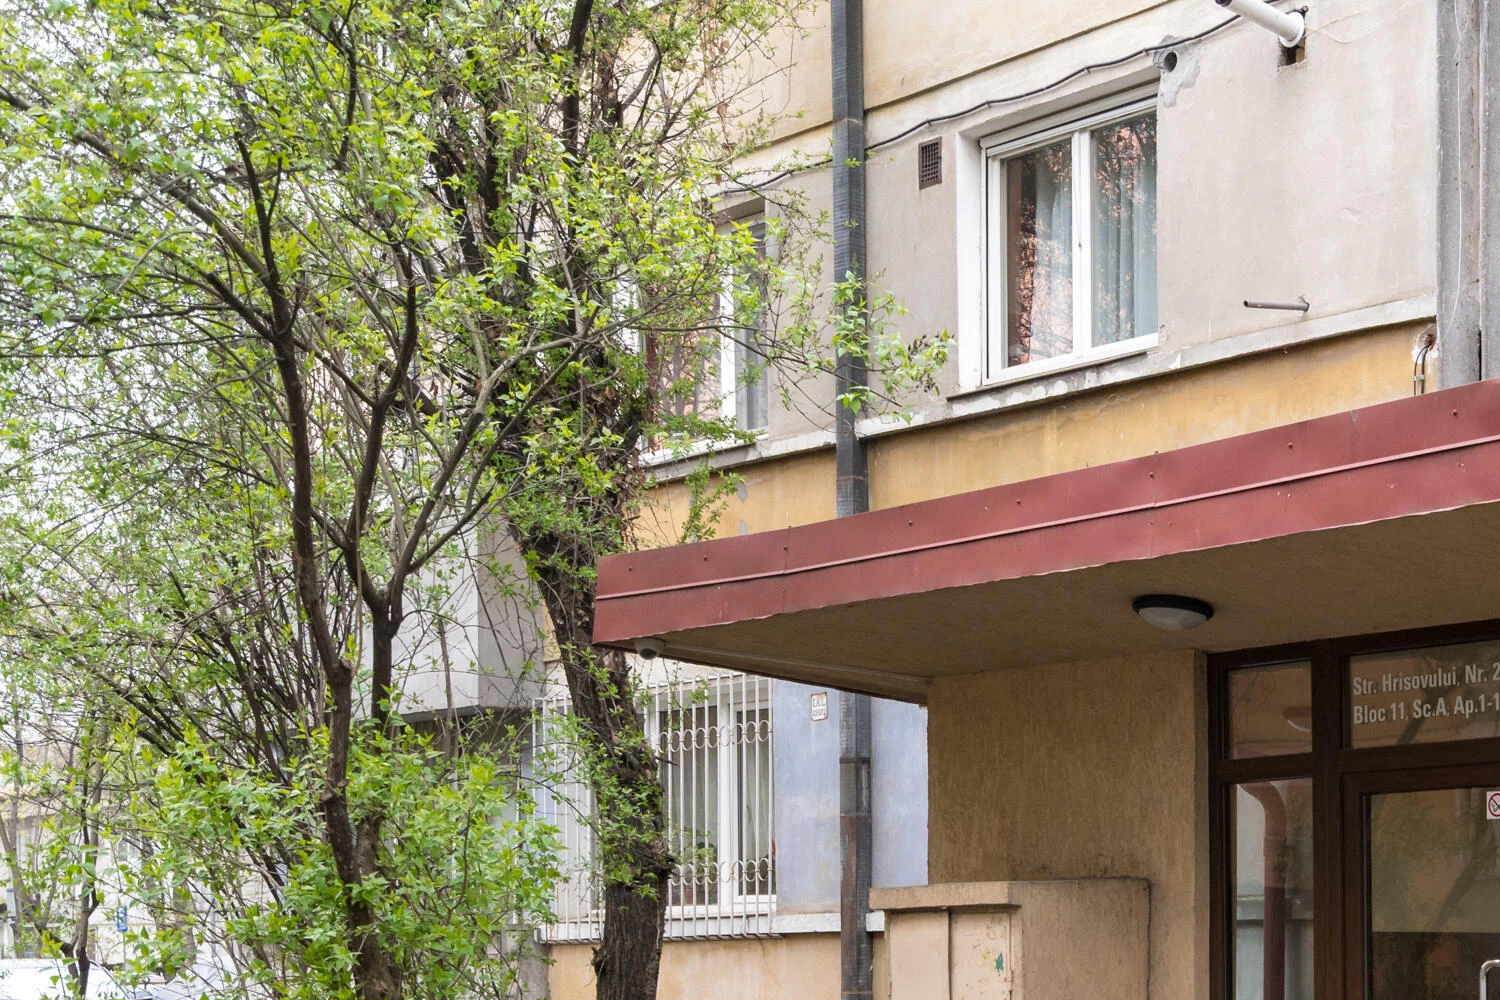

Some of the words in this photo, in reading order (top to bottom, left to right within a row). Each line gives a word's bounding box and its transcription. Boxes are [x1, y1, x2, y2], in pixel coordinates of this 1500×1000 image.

[1353, 677, 1377, 696] Str.
[1382, 667, 1460, 692] Hrisovului,
[1465, 664, 1488, 685] Nr.
[1353, 705, 1386, 724] Bloc
[1390, 702, 1409, 721] 11,
[1412, 697, 1450, 719] Sc.A,
